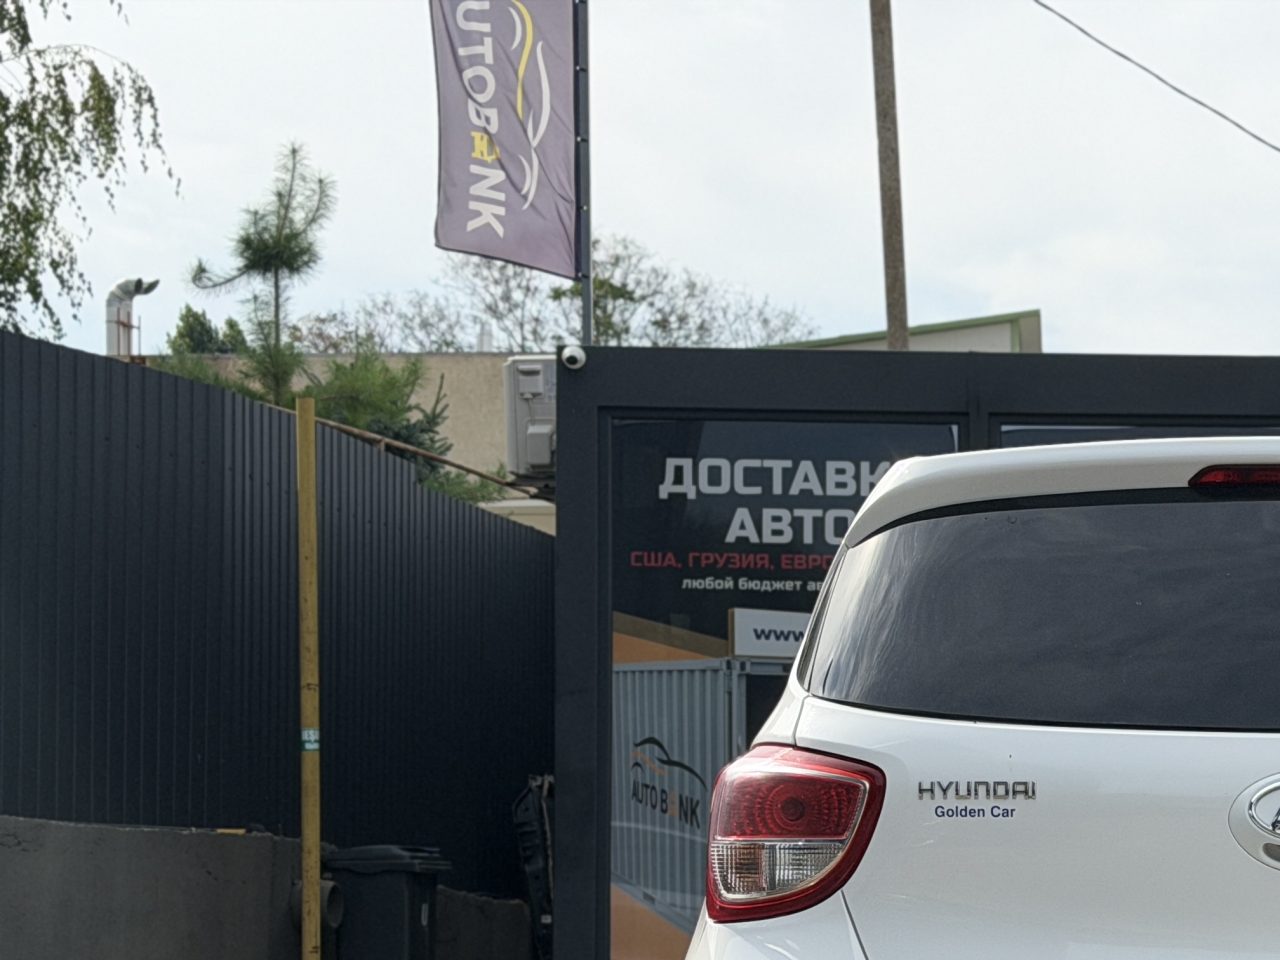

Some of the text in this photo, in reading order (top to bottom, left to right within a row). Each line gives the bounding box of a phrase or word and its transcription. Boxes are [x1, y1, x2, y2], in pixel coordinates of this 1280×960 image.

[455, 0, 506, 239] UTOBANK
[658, 457, 890, 500] ДОСТАВК
[681, 576, 734, 590] любой
[738, 577, 803, 592] бюджет
[631, 779, 658, 810] AUTO
[918, 781, 1036, 800] HYUNDAI
[934, 805, 1016, 818] Golden Car
